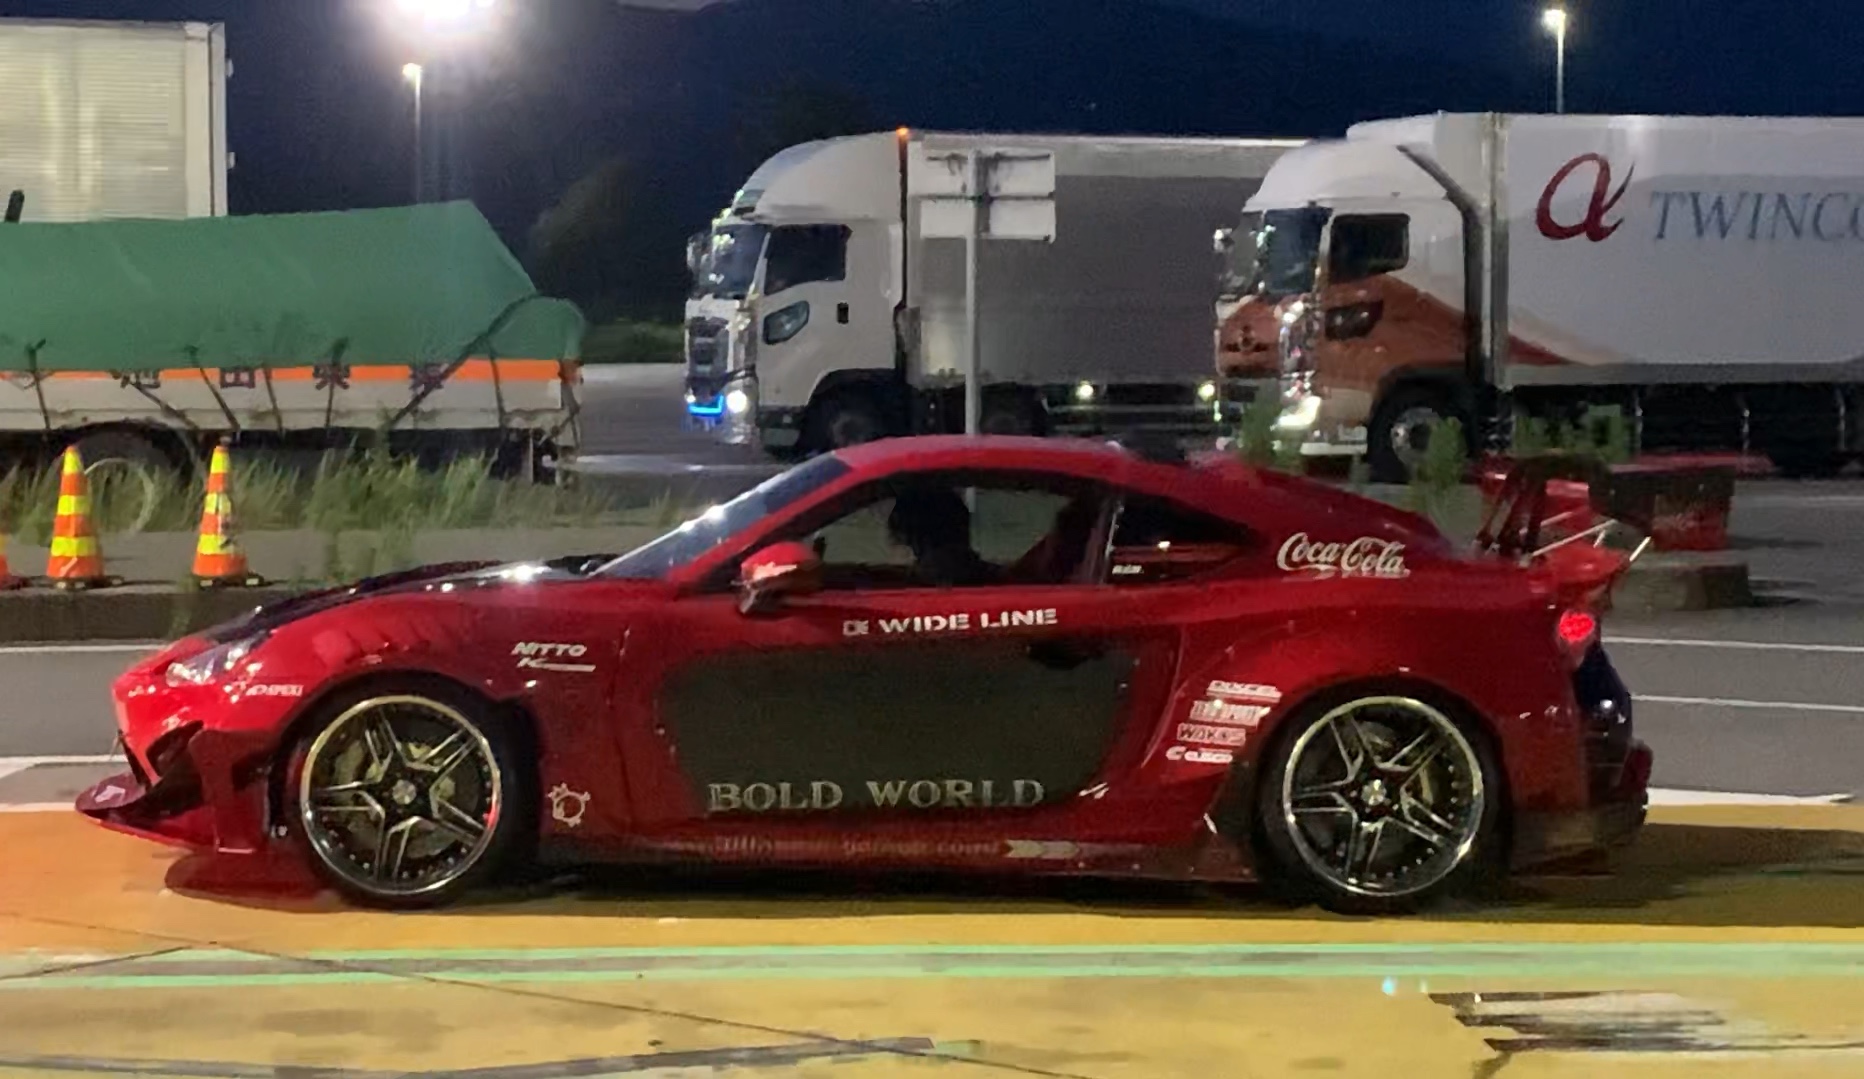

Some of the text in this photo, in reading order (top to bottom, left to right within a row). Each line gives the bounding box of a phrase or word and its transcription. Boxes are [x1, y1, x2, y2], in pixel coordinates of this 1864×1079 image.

[878, 612, 971, 633] WIDE
[980, 607, 1058, 628] LINE
[511, 642, 588, 657] NITTO
[707, 778, 1045, 812] BOLD WORLD
